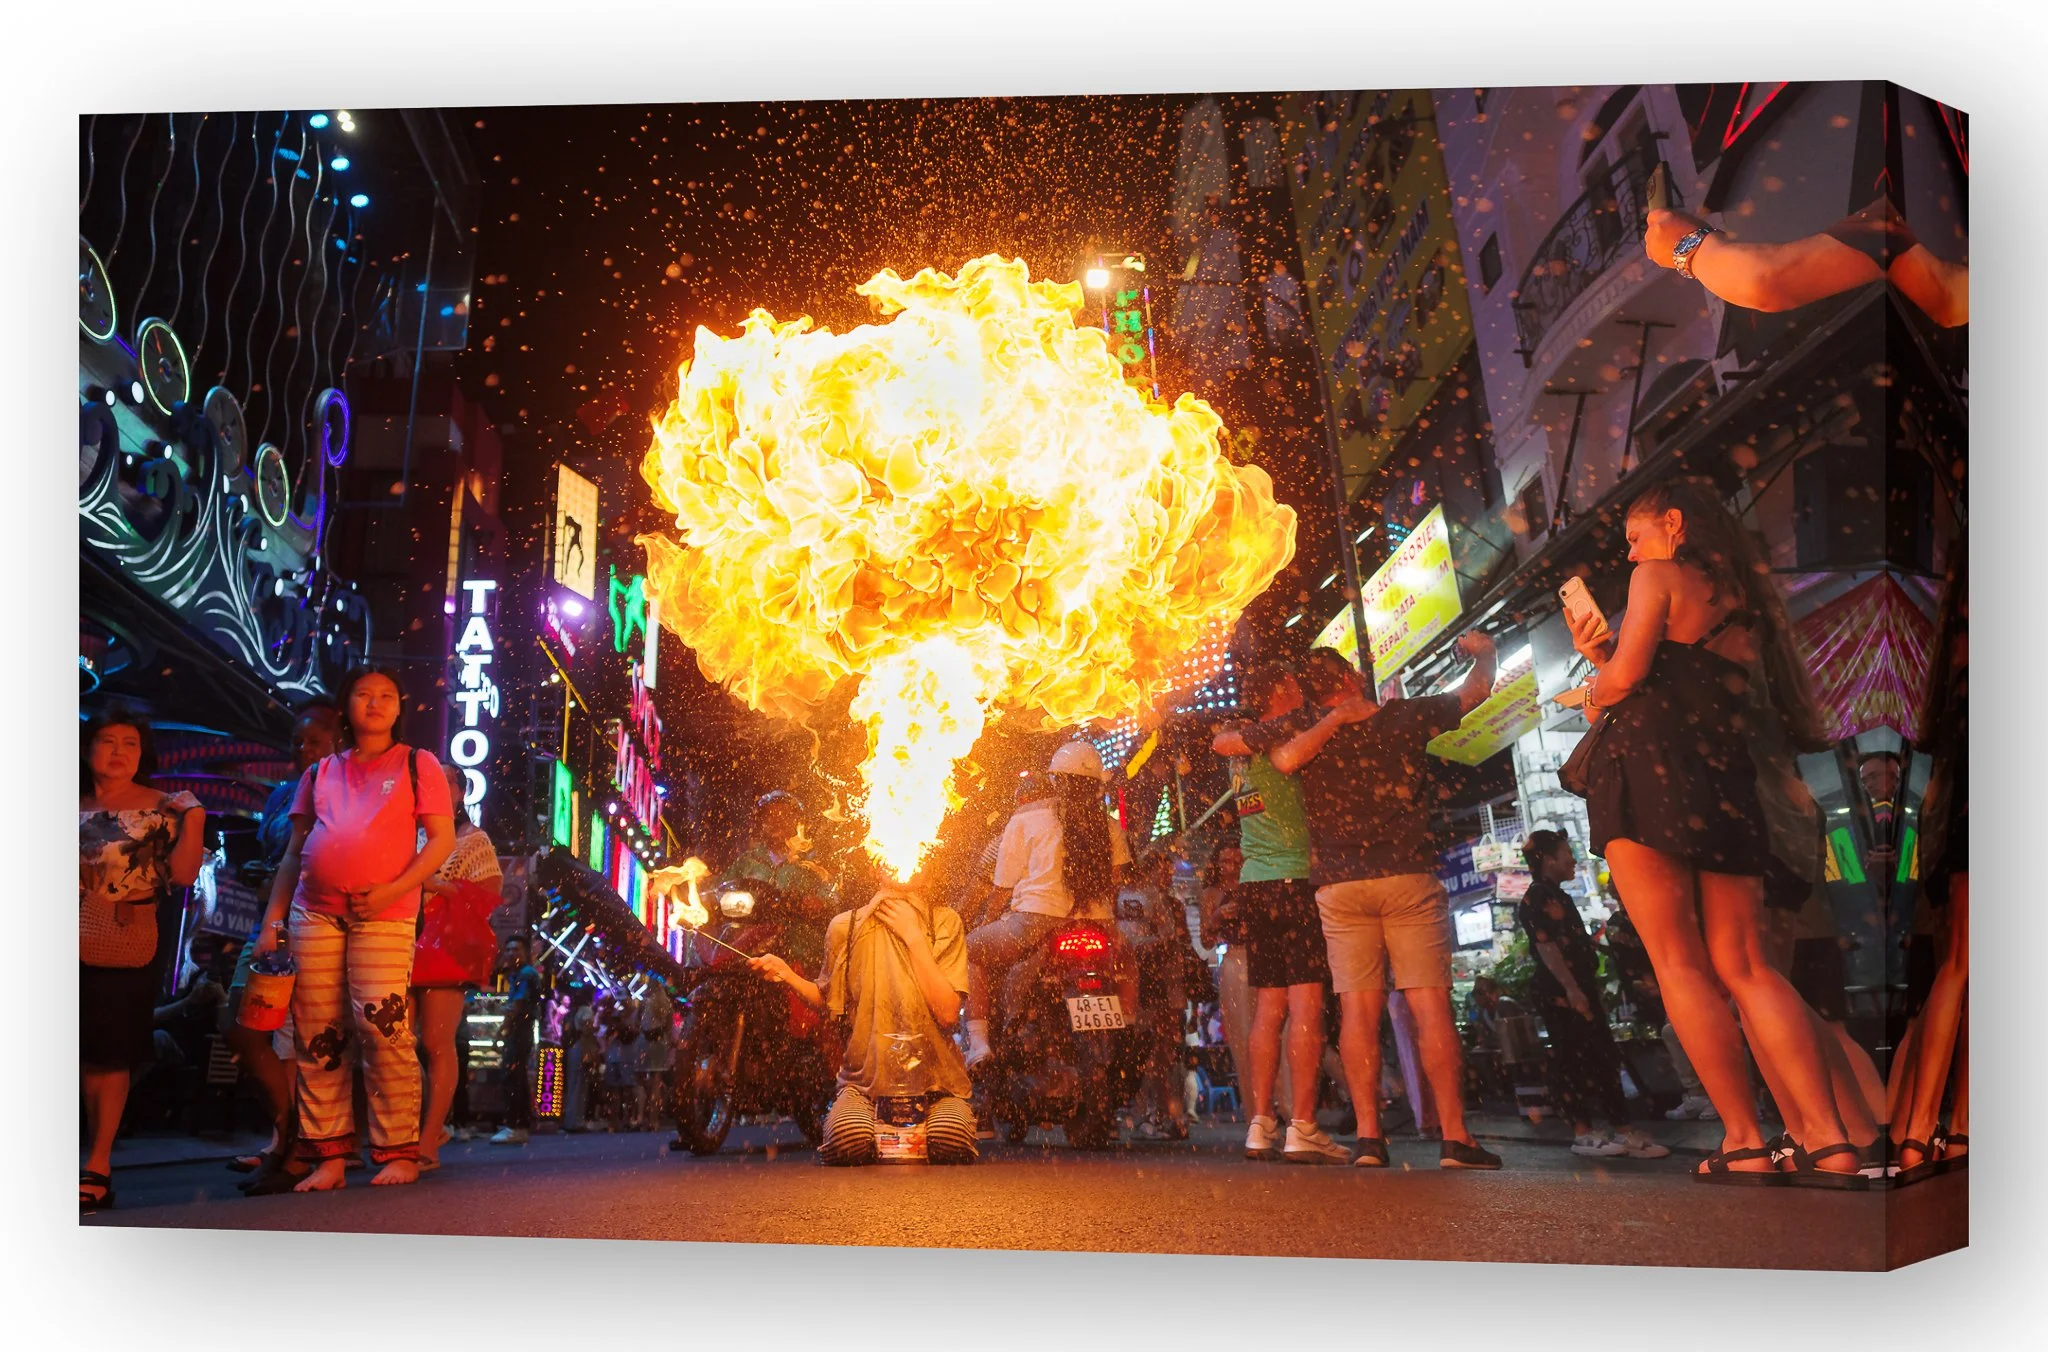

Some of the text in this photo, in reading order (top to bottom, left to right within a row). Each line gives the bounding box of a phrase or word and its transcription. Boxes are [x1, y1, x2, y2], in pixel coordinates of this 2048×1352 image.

[1393, 594, 1416, 622] DATA
[1378, 620, 1410, 656] REPAIR
[450, 580, 497, 805] TATTOO
[1076, 997, 1113, 1012] 48-E1
[541, 1051, 555, 1113] TATTOO
